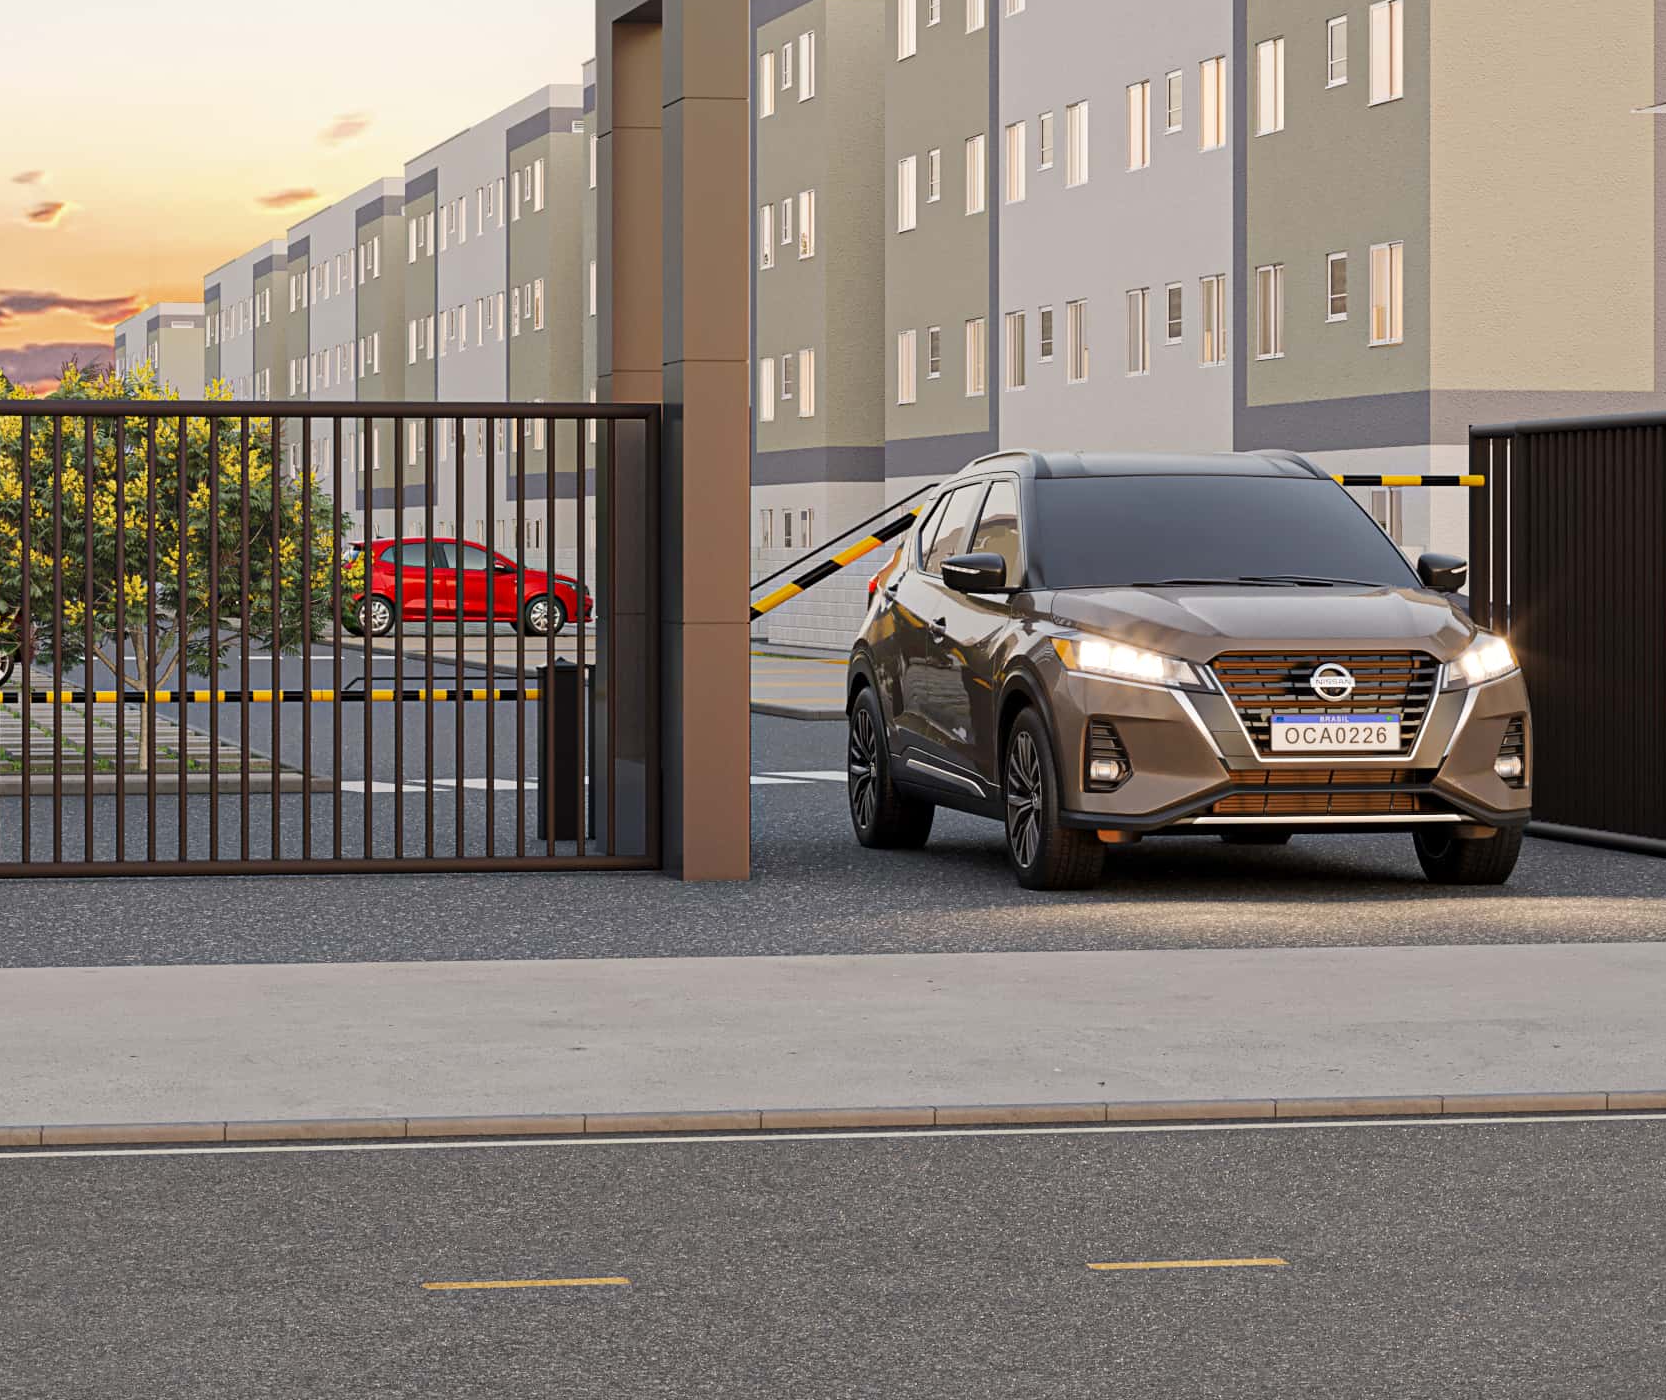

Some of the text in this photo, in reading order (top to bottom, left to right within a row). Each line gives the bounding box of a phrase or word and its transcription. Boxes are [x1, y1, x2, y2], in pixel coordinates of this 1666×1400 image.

[1315, 678, 1351, 686] NISSAN
[1319, 715, 1350, 723] BRASIL
[1285, 727, 1387, 745] OCA0226
